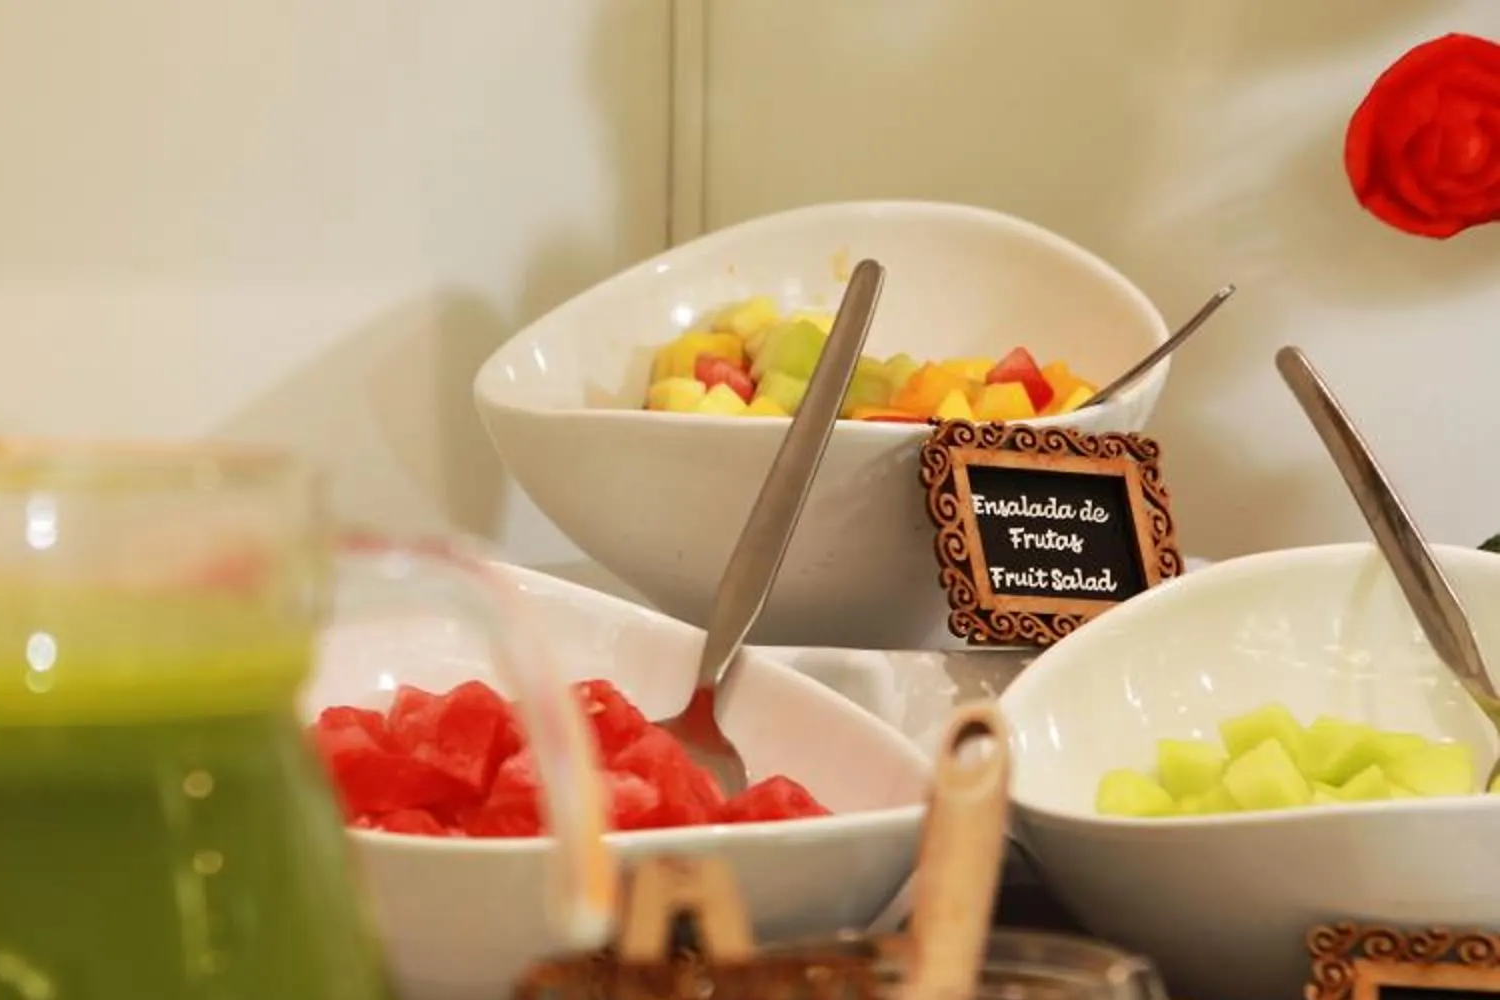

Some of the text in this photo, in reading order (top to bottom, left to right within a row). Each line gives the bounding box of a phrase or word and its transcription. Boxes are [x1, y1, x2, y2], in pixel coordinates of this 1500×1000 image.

[970, 494, 1109, 523] Ensalada de
[1008, 527, 1085, 553] Frutas
[989, 567, 1118, 592] Fruit Salad
